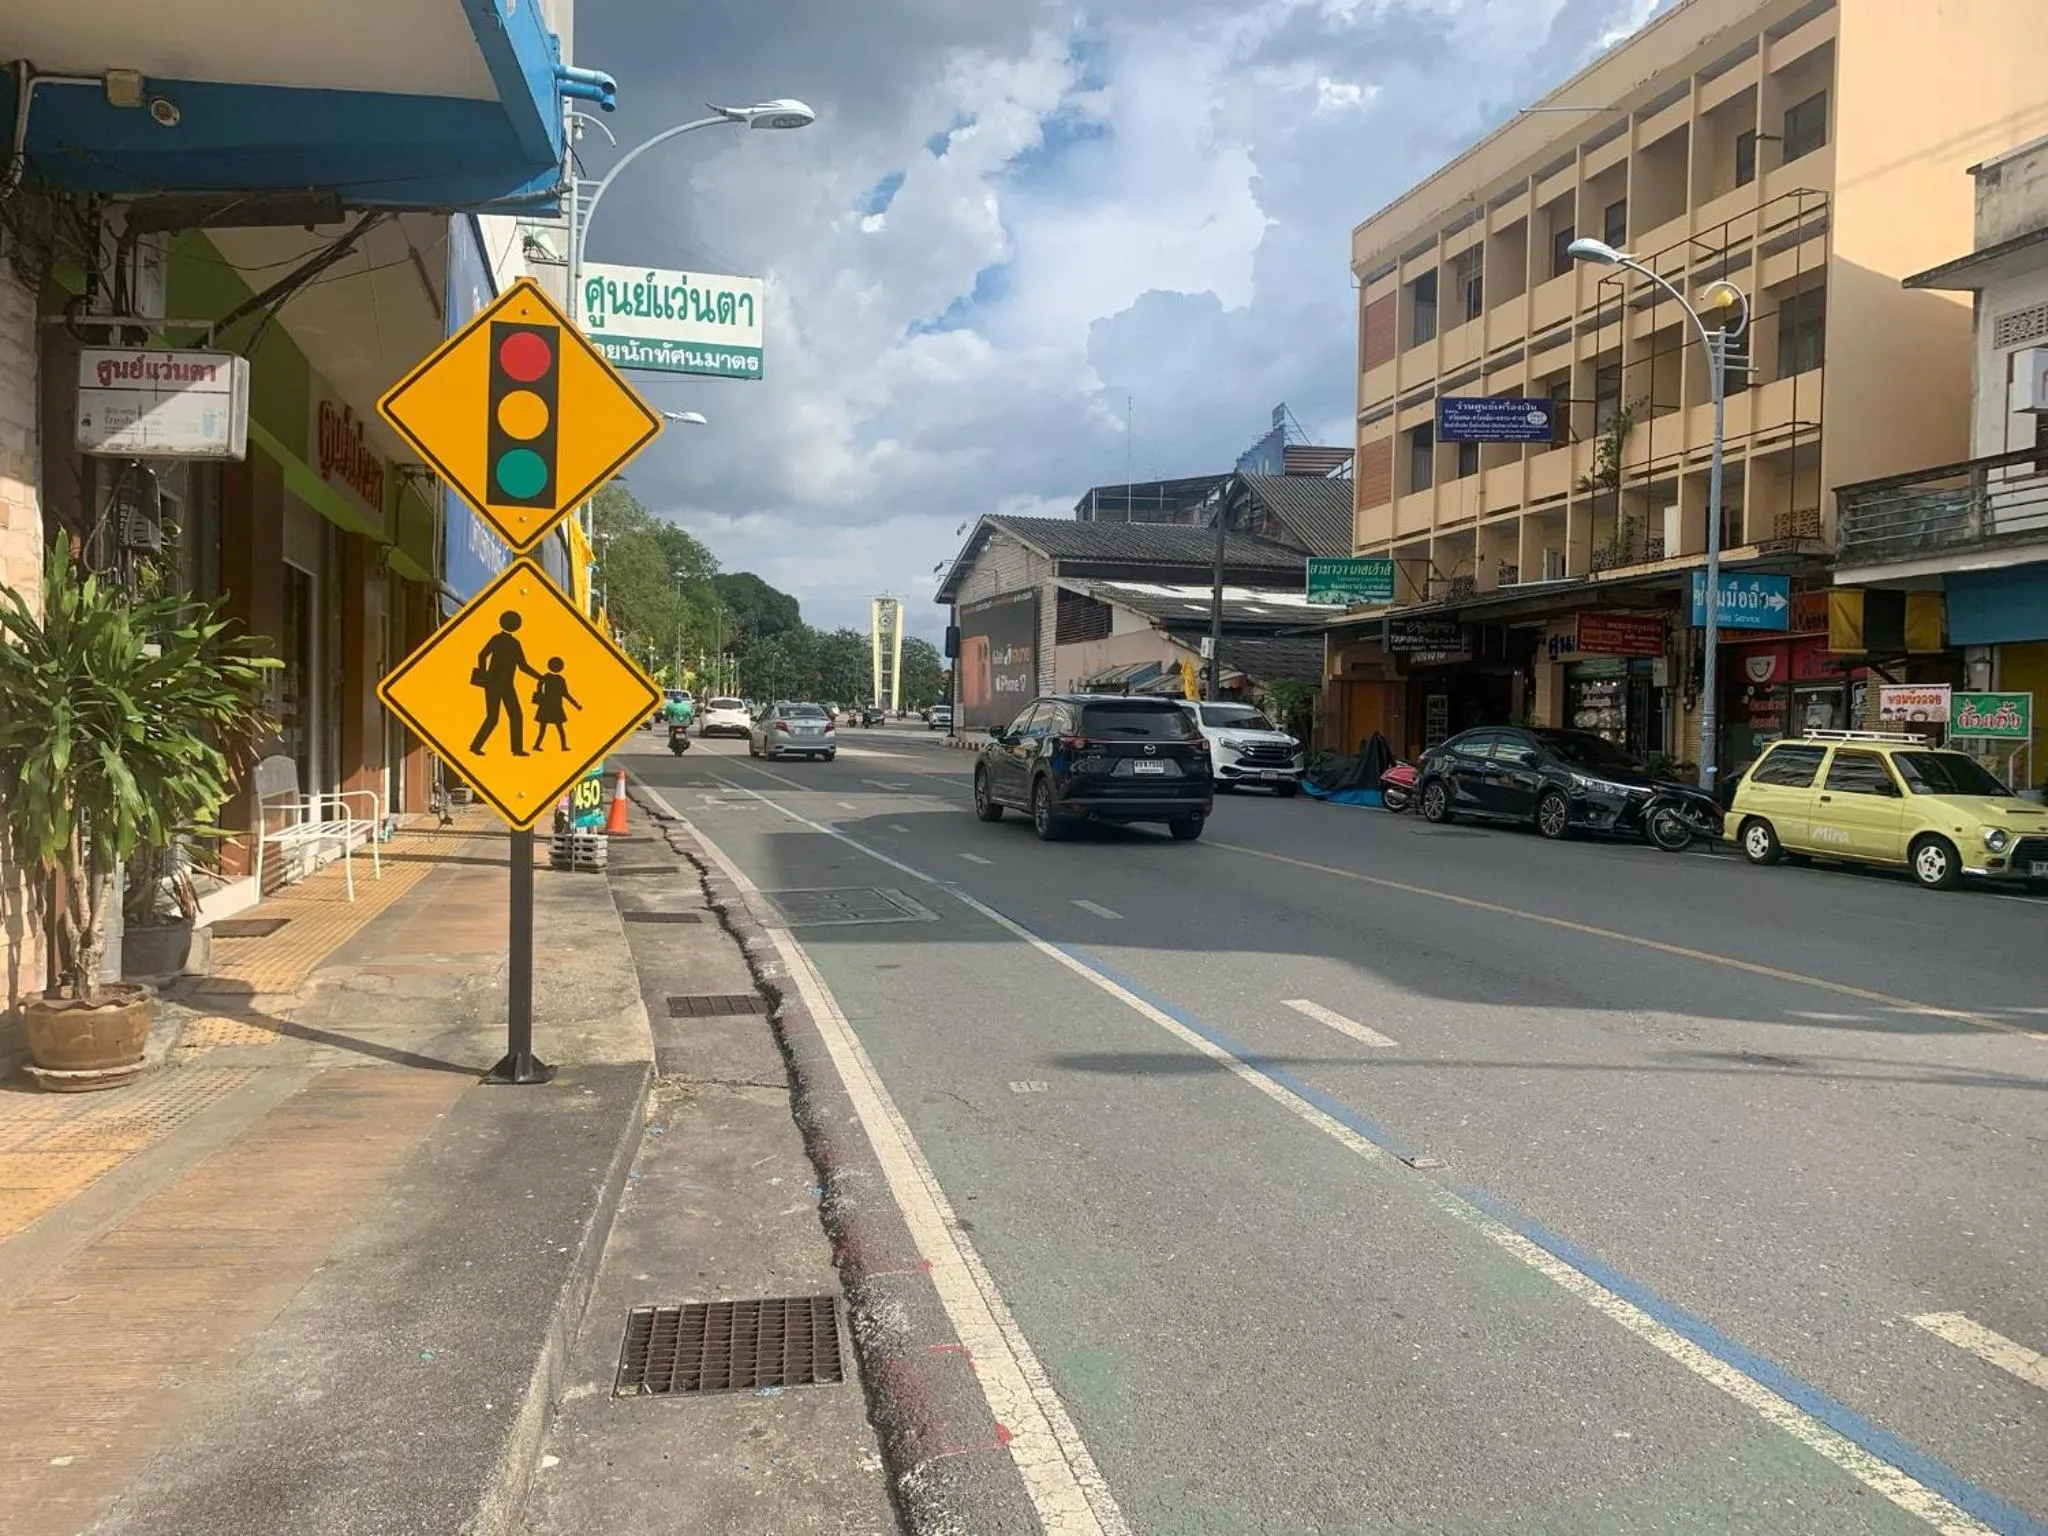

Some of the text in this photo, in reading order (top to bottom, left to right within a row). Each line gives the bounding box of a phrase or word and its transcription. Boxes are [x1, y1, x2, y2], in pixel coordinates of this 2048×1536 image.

[585, 271, 754, 328] ศูนย์แว่นตา
[96, 353, 217, 387] ศูนย์แว่นตา
[585, 334, 759, 371] ดยนักทัศนมาตร
